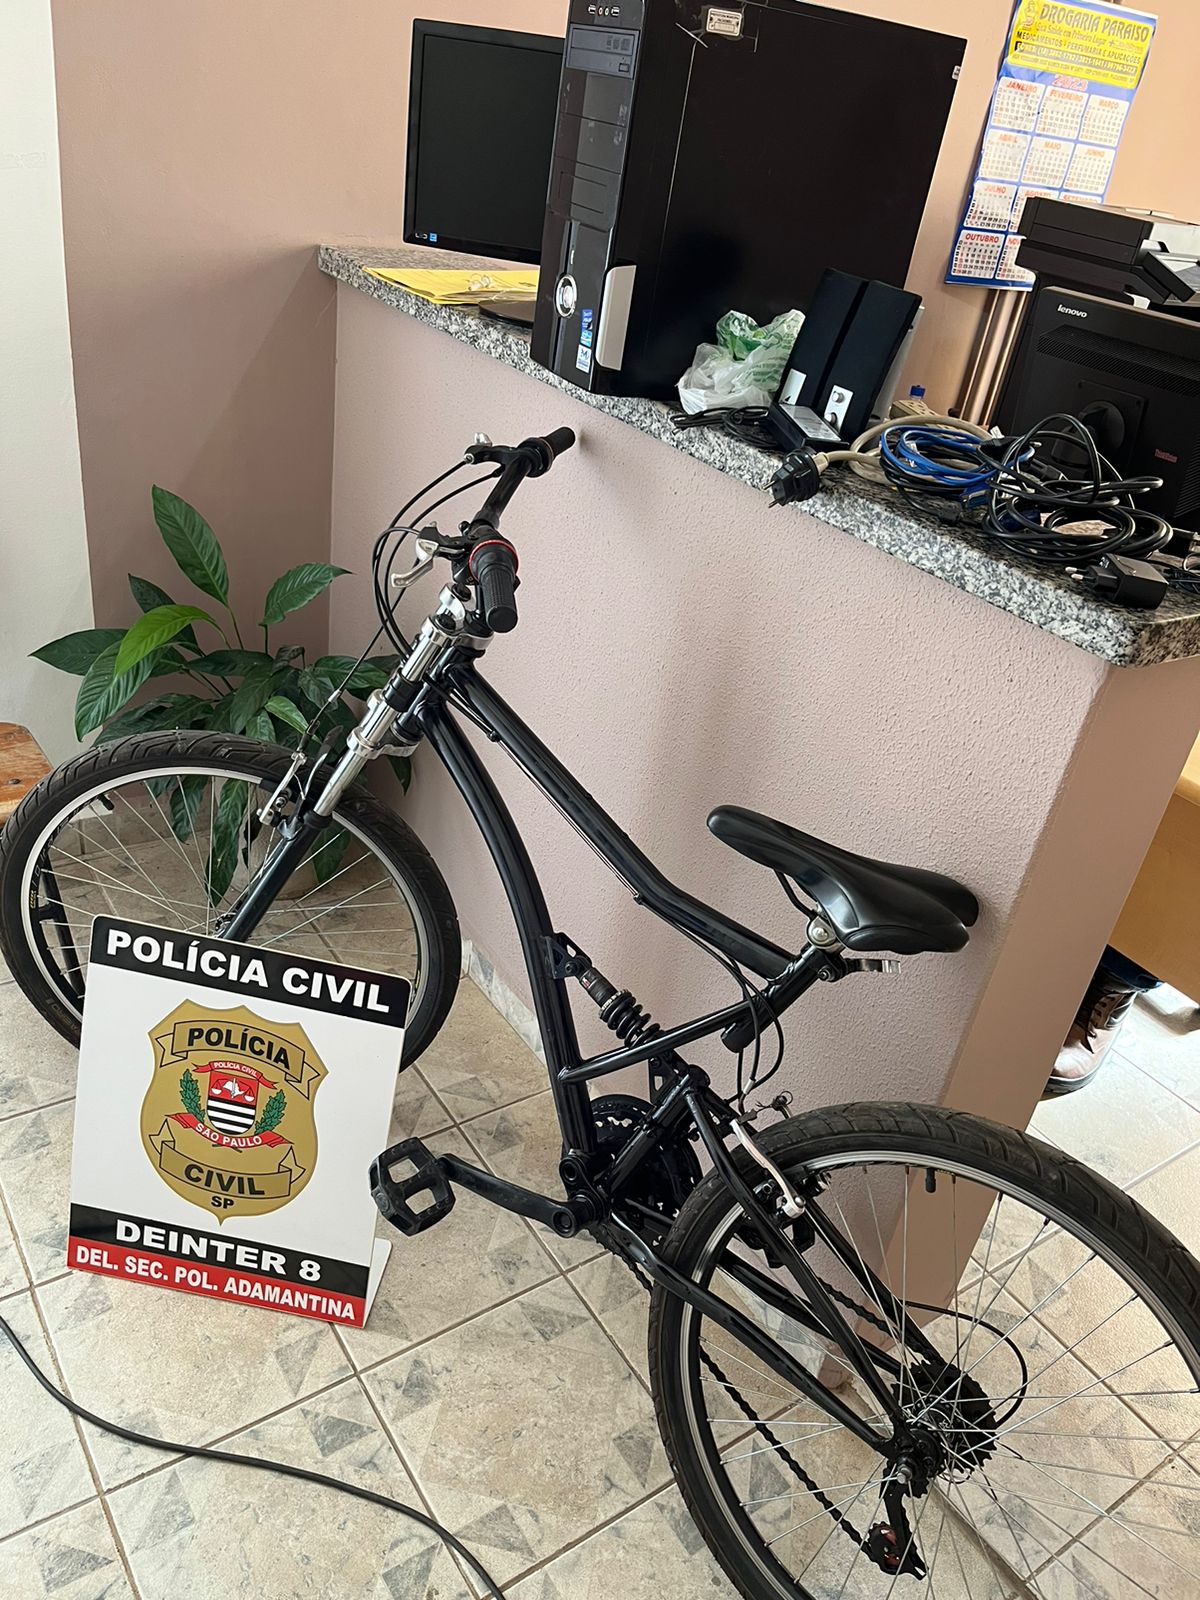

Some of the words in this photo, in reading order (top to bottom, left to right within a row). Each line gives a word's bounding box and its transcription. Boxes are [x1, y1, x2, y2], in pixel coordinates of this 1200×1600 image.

[1040, 4, 1099, 32] DROGARIA
[1017, 31, 1062, 46] MEDICAMENTOS
[1007, 81, 1037, 93] JANEIRO
[1050, 90, 1084, 100] FEVEREIRO
[1052, 74, 1088, 91] 2023
[1044, 141, 1061, 149] MAIO
[985, 184, 1006, 194] JULHO
[966, 233, 999, 243] OUTUBRO
[1058, 304, 1087, 318] lenovo
[106, 928, 268, 987] POLÍCIA
[282, 967, 389, 1013] CIVIL
[188, 1028, 290, 1070] POLÍCIA
[242, 1066, 257, 1077] CIVIL
[223, 1136, 262, 1147] PAULO
[185, 1164, 265, 1195] CIVIL
[211, 1196, 234, 1208] SP
[116, 1220, 286, 1275] DEINTER
[300, 1259, 321, 1282] 8
[76, 1246, 118, 1270] DEL.
[125, 1255, 168, 1281] SEC.
[175, 1265, 218, 1291] POL.
[224, 1275, 355, 1320] ADAMANTINA
